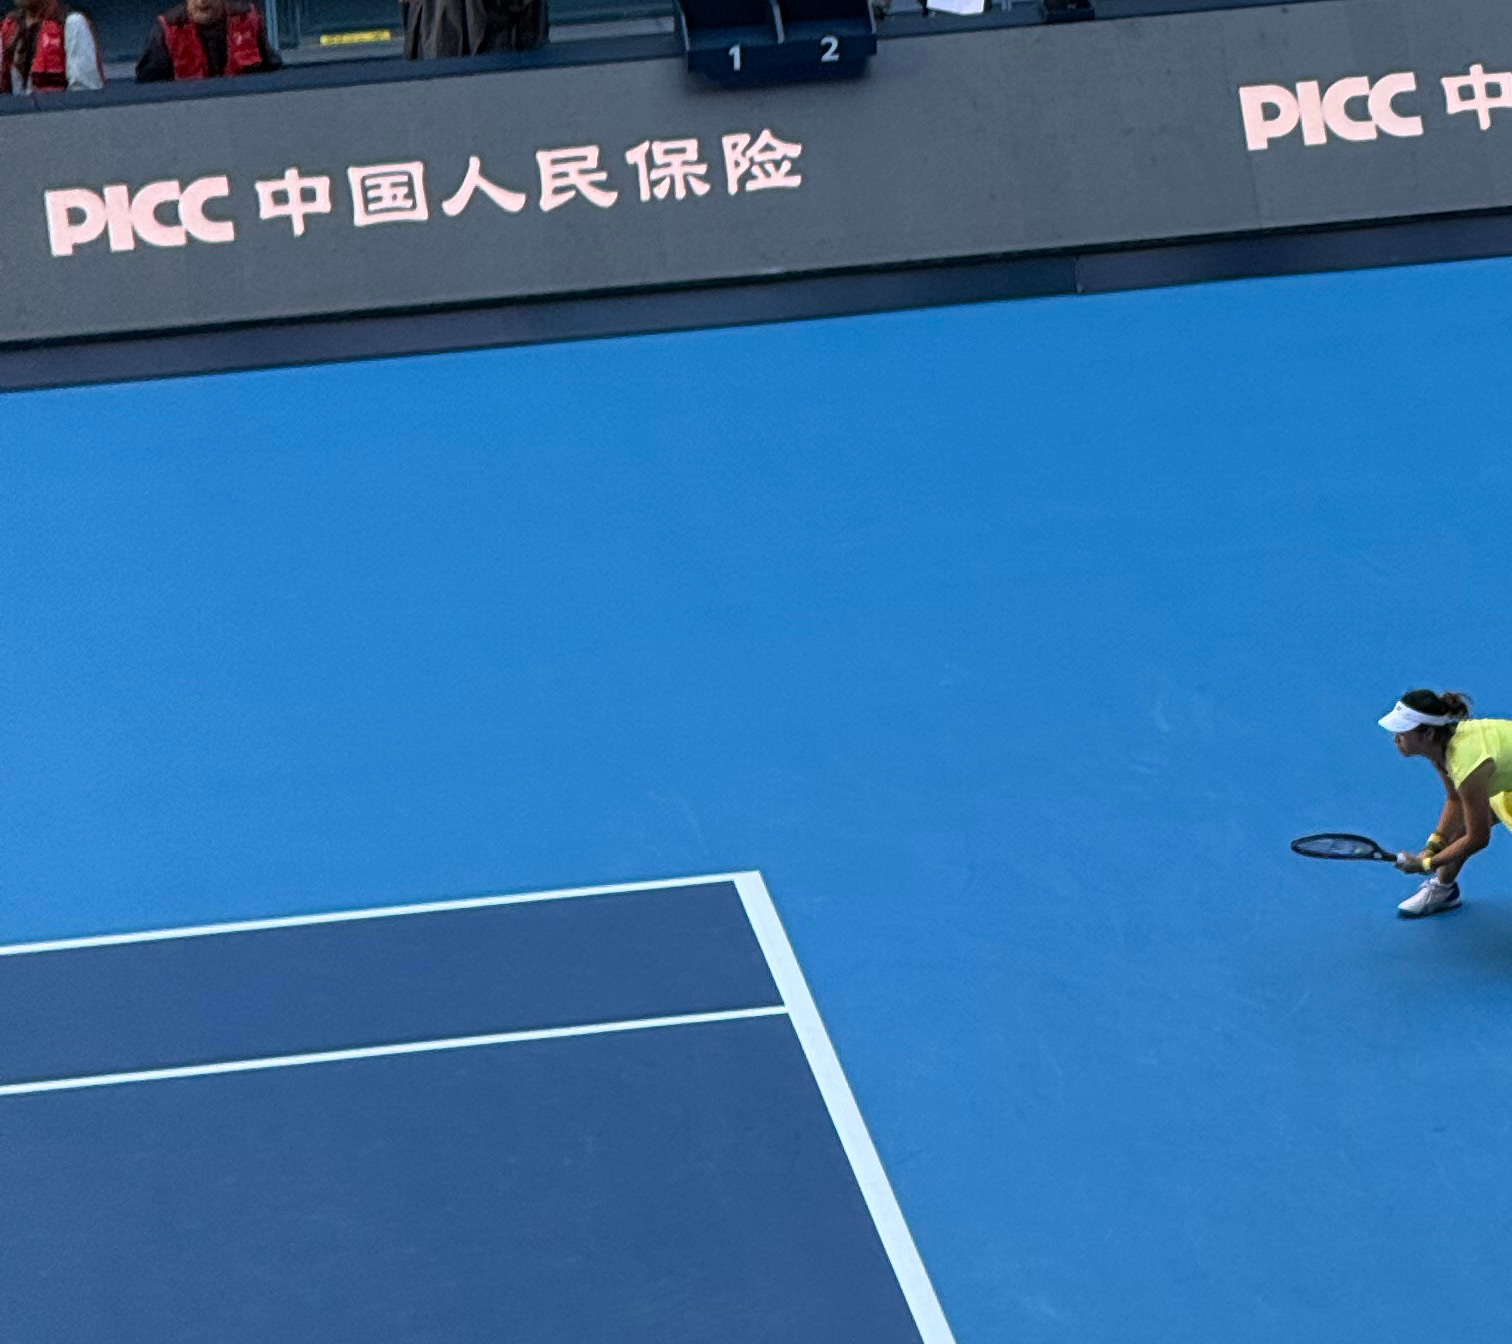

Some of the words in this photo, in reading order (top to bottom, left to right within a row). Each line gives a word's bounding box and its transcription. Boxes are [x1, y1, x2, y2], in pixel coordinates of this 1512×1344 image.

[728, 45, 742, 71] 1
[820, 36, 840, 62] 2
[1238, 71, 1424, 151] PICC
[44, 175, 235, 257] PICC
[254, 129, 803, 237] 中国人民保险
